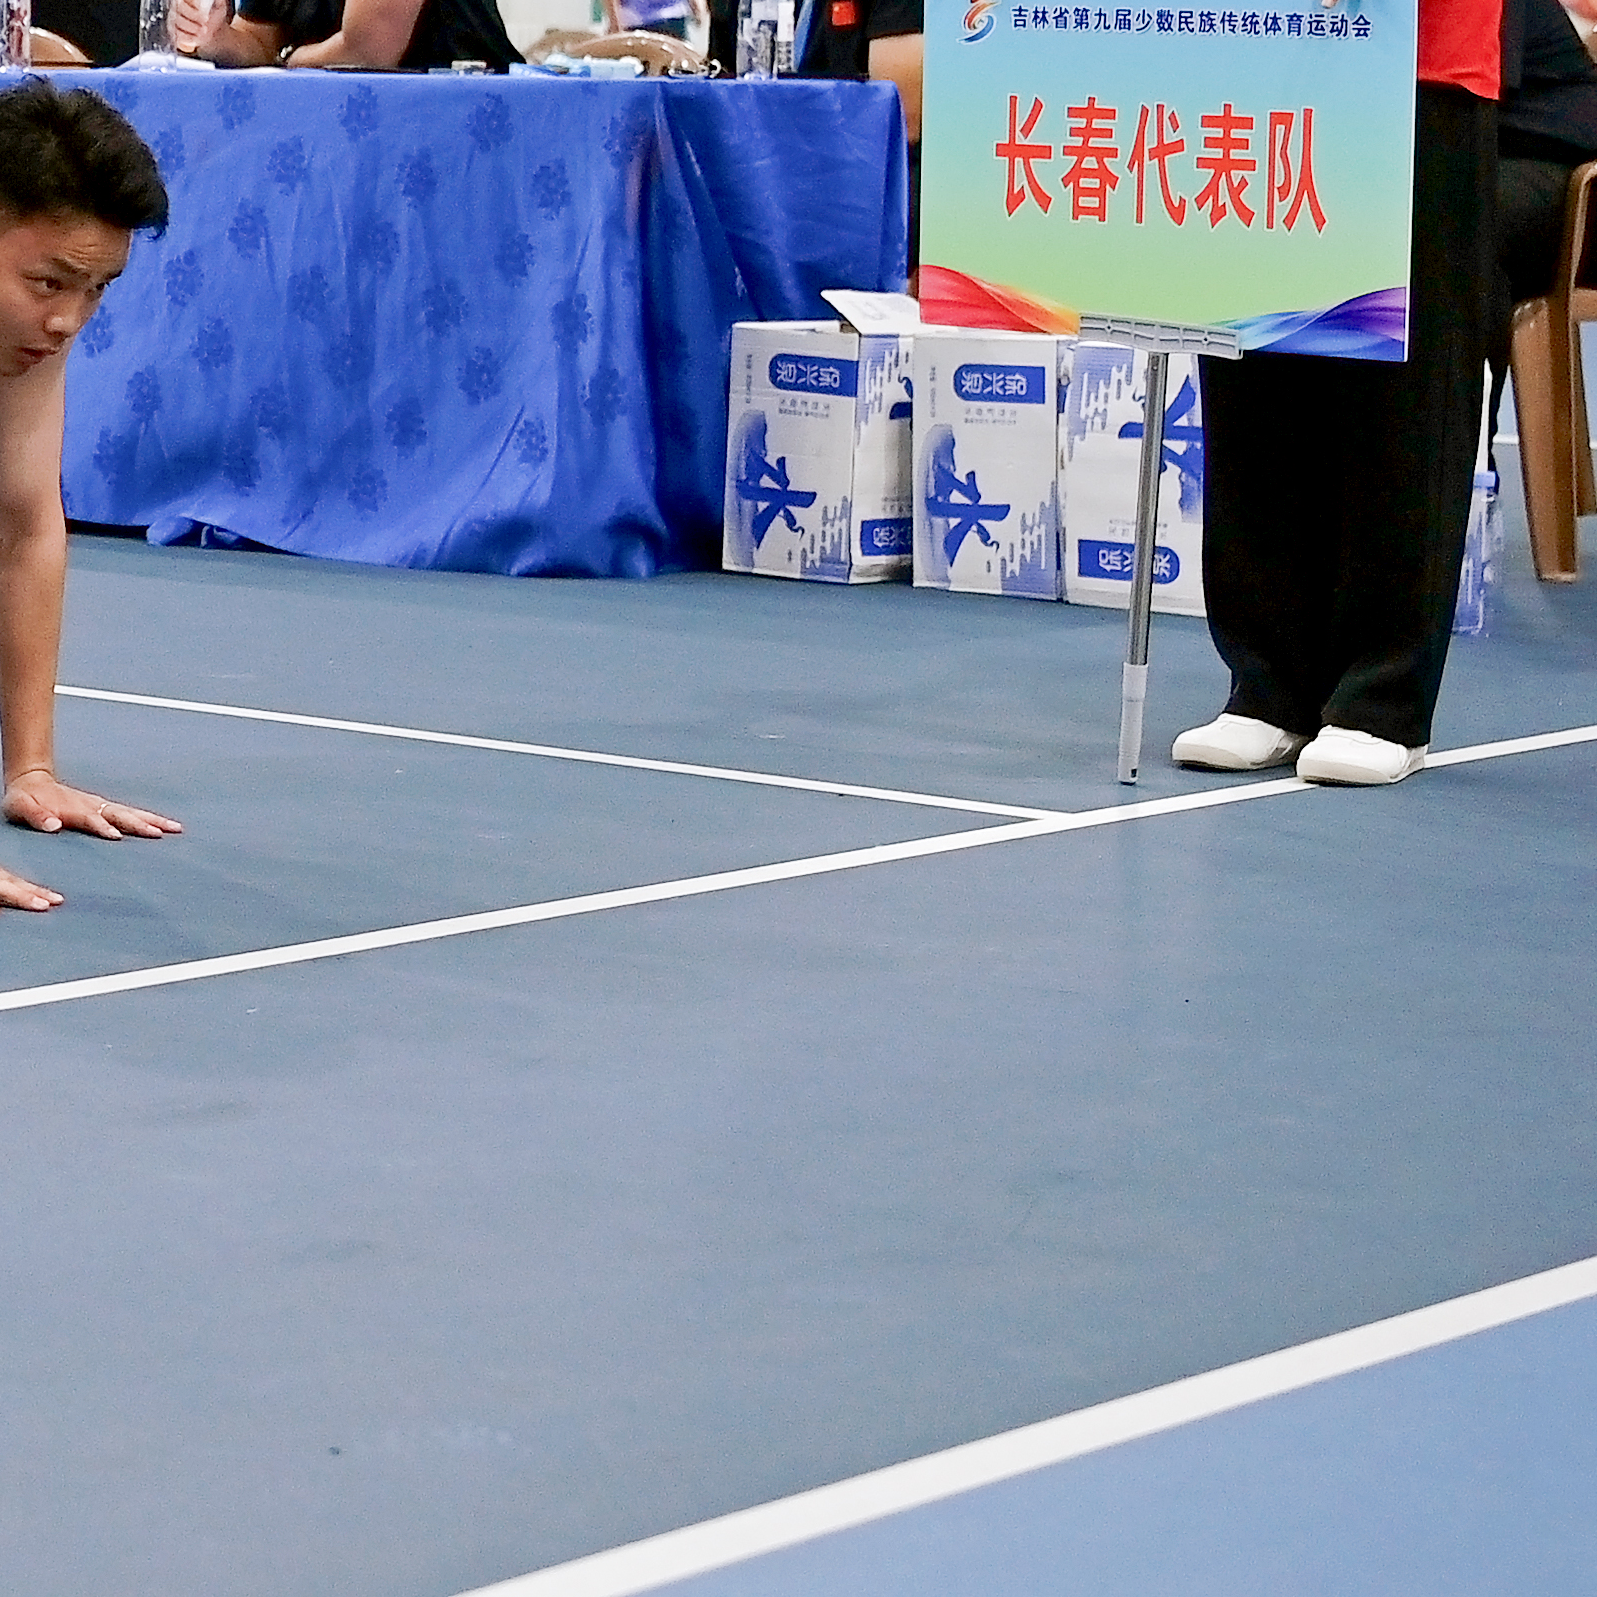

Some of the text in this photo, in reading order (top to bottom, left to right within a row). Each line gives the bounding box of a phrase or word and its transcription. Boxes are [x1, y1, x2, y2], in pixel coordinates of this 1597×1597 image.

[1010, 4, 1374, 40] 吉林省第九届少数民族传统体育运动会
[994, 94, 1329, 236] 长春代表队
[775, 360, 840, 390] 保兴泉
[961, 371, 1028, 396] 保兴泉
